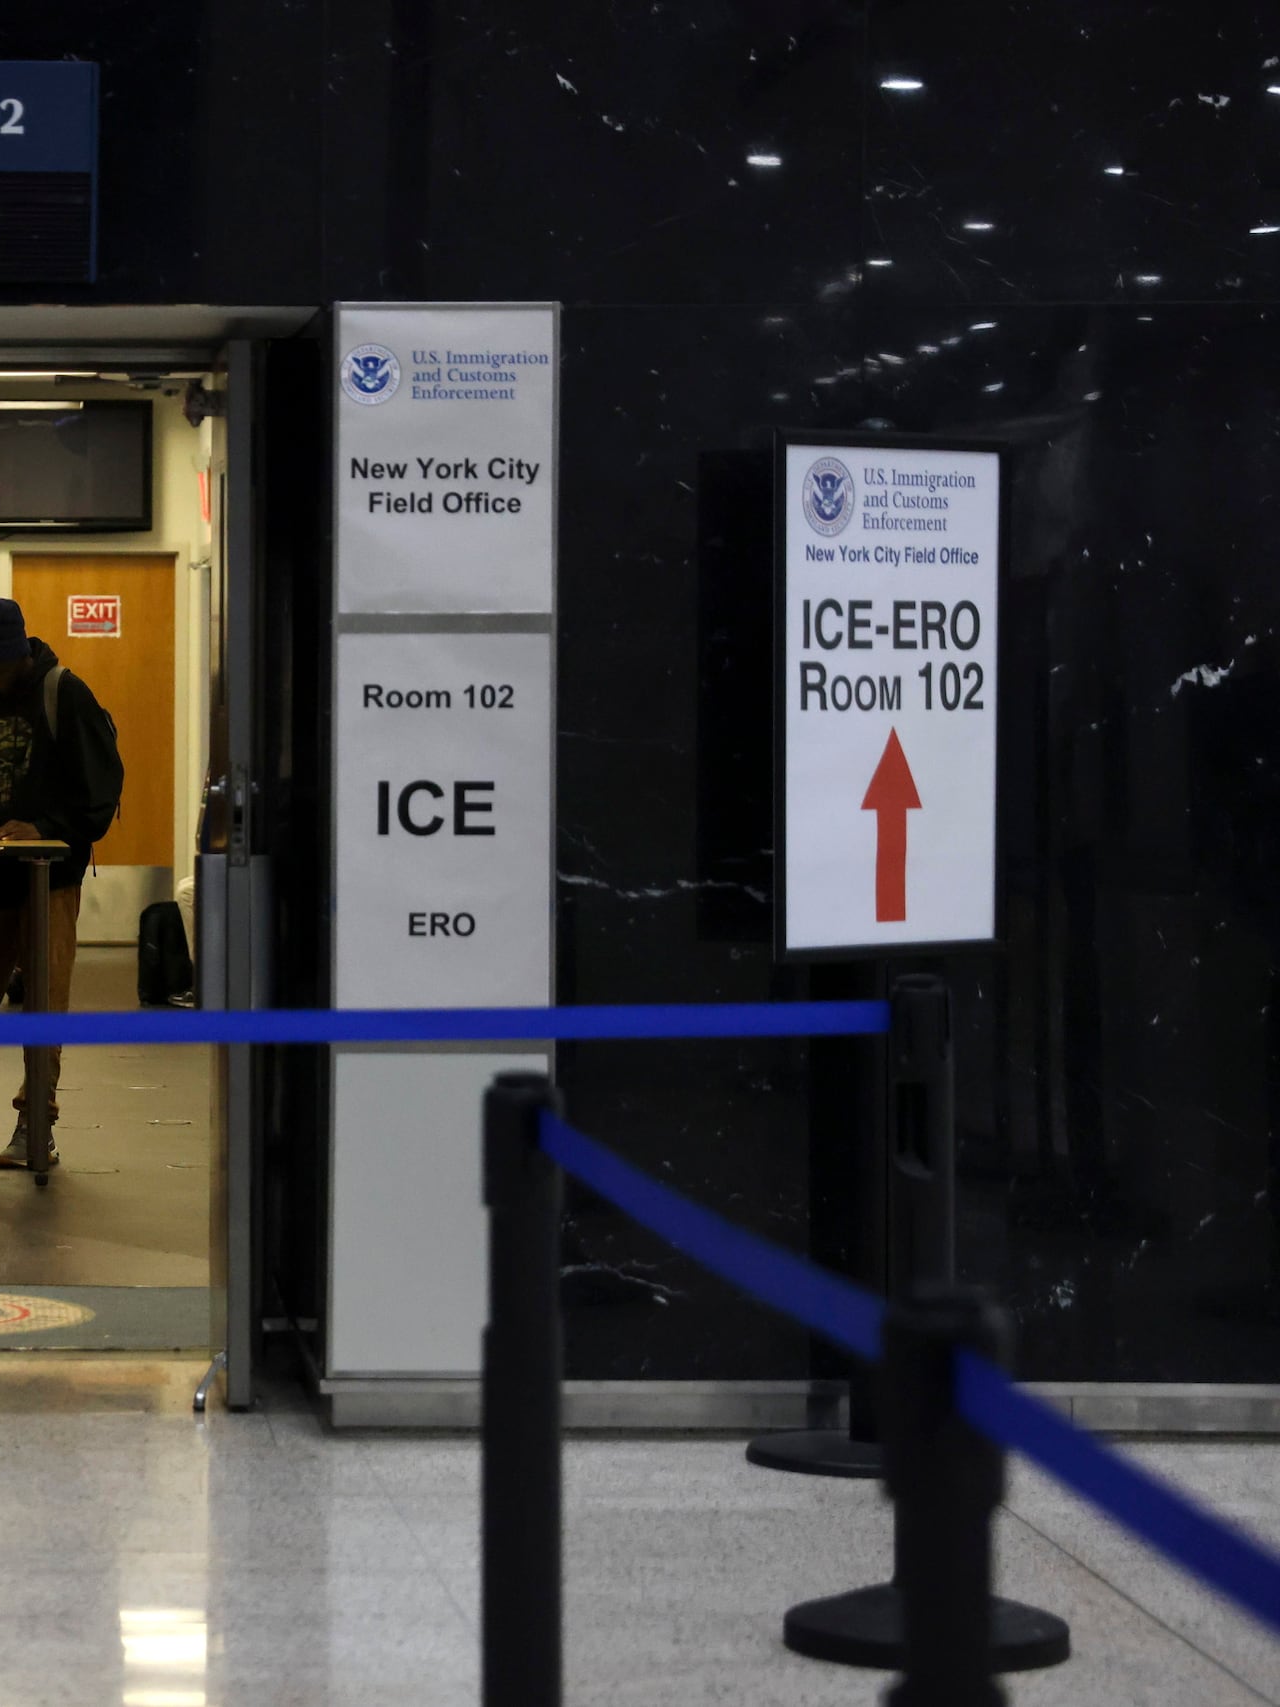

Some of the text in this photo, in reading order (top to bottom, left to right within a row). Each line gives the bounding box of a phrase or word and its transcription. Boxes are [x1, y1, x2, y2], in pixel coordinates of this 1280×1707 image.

[412, 351, 549, 368] U.S. Immigration
[412, 369, 516, 383] and Customs
[412, 386, 515, 400] Enforcement
[351, 457, 540, 485] New York City
[863, 468, 976, 493] U.S. Immigration
[369, 491, 522, 513] Field Office
[863, 492, 949, 509] and Customs
[863, 512, 948, 532] Enforcement
[805, 544, 979, 567] New York City Field Office
[71, 602, 116, 619] EXIT
[802, 598, 981, 650] ICE-ERO
[363, 684, 515, 709] Room 102
[918, 662, 984, 711] 102
[377, 779, 496, 836] ICE
[408, 912, 476, 937] ERO
